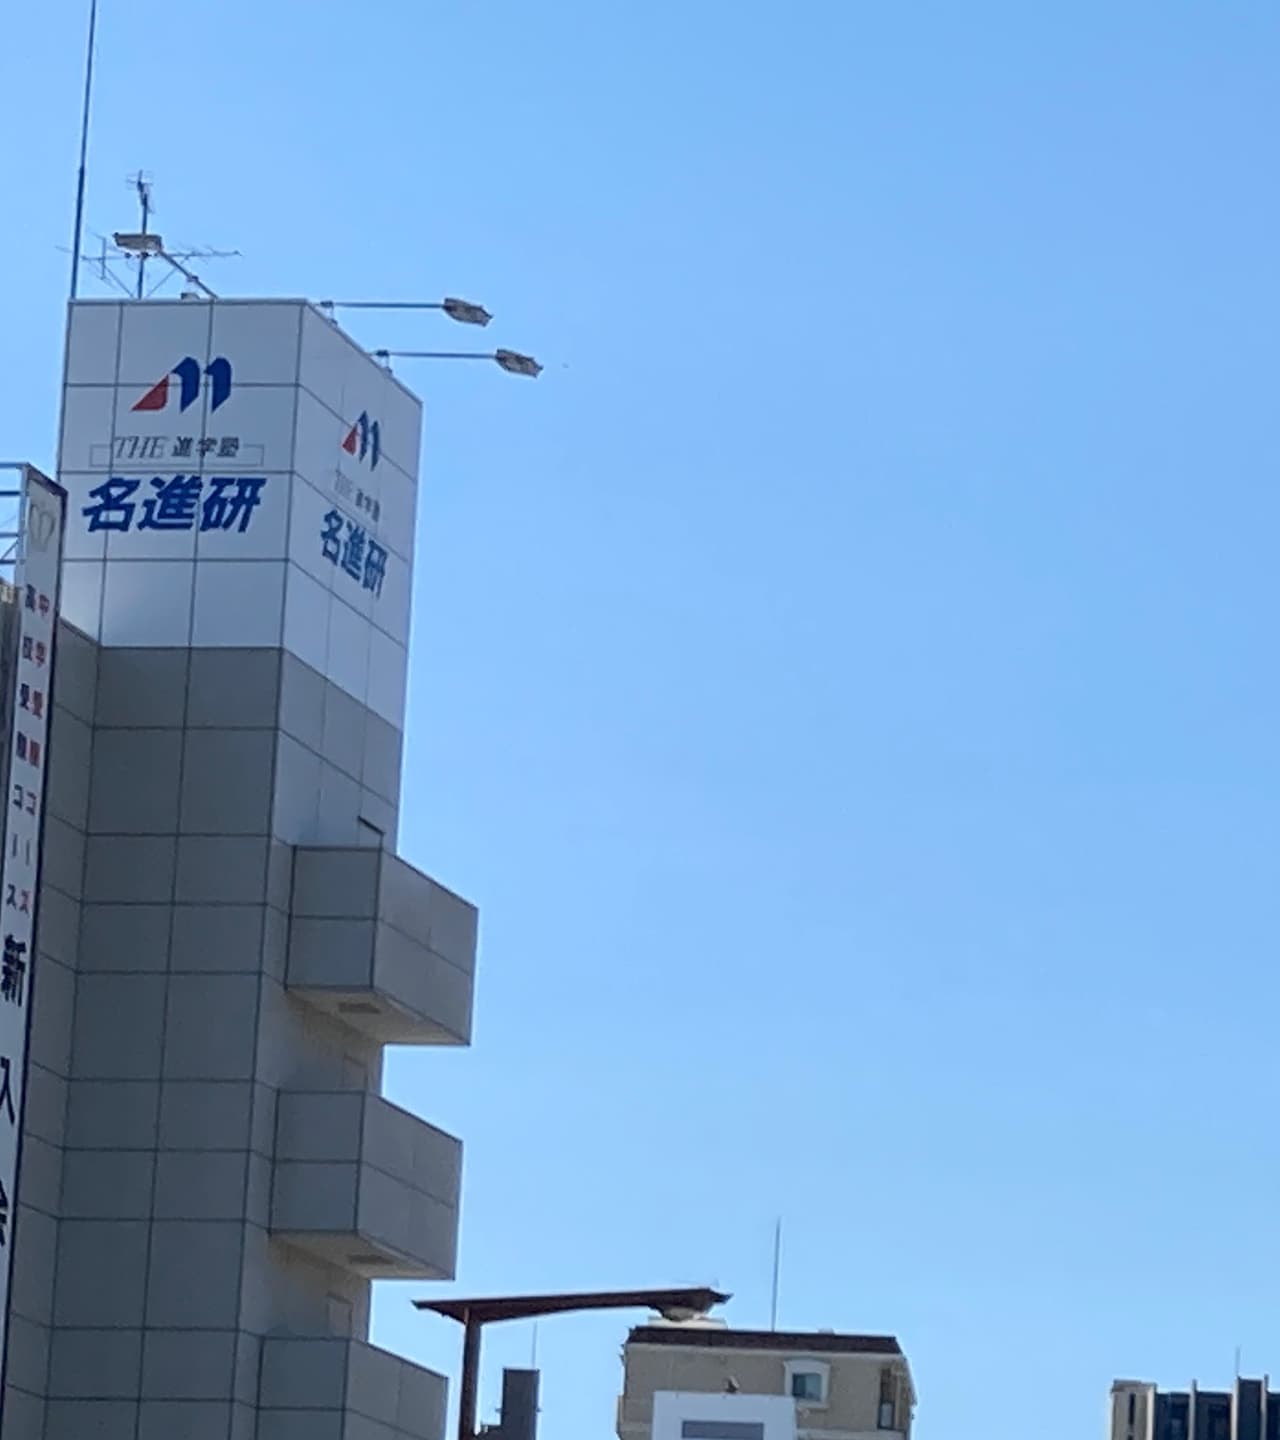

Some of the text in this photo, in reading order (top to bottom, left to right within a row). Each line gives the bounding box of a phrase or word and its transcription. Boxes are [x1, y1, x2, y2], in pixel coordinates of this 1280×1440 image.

[113, 436, 168, 458] THE
[82, 475, 266, 532] 名進研
[320, 508, 388, 600] 名進研
